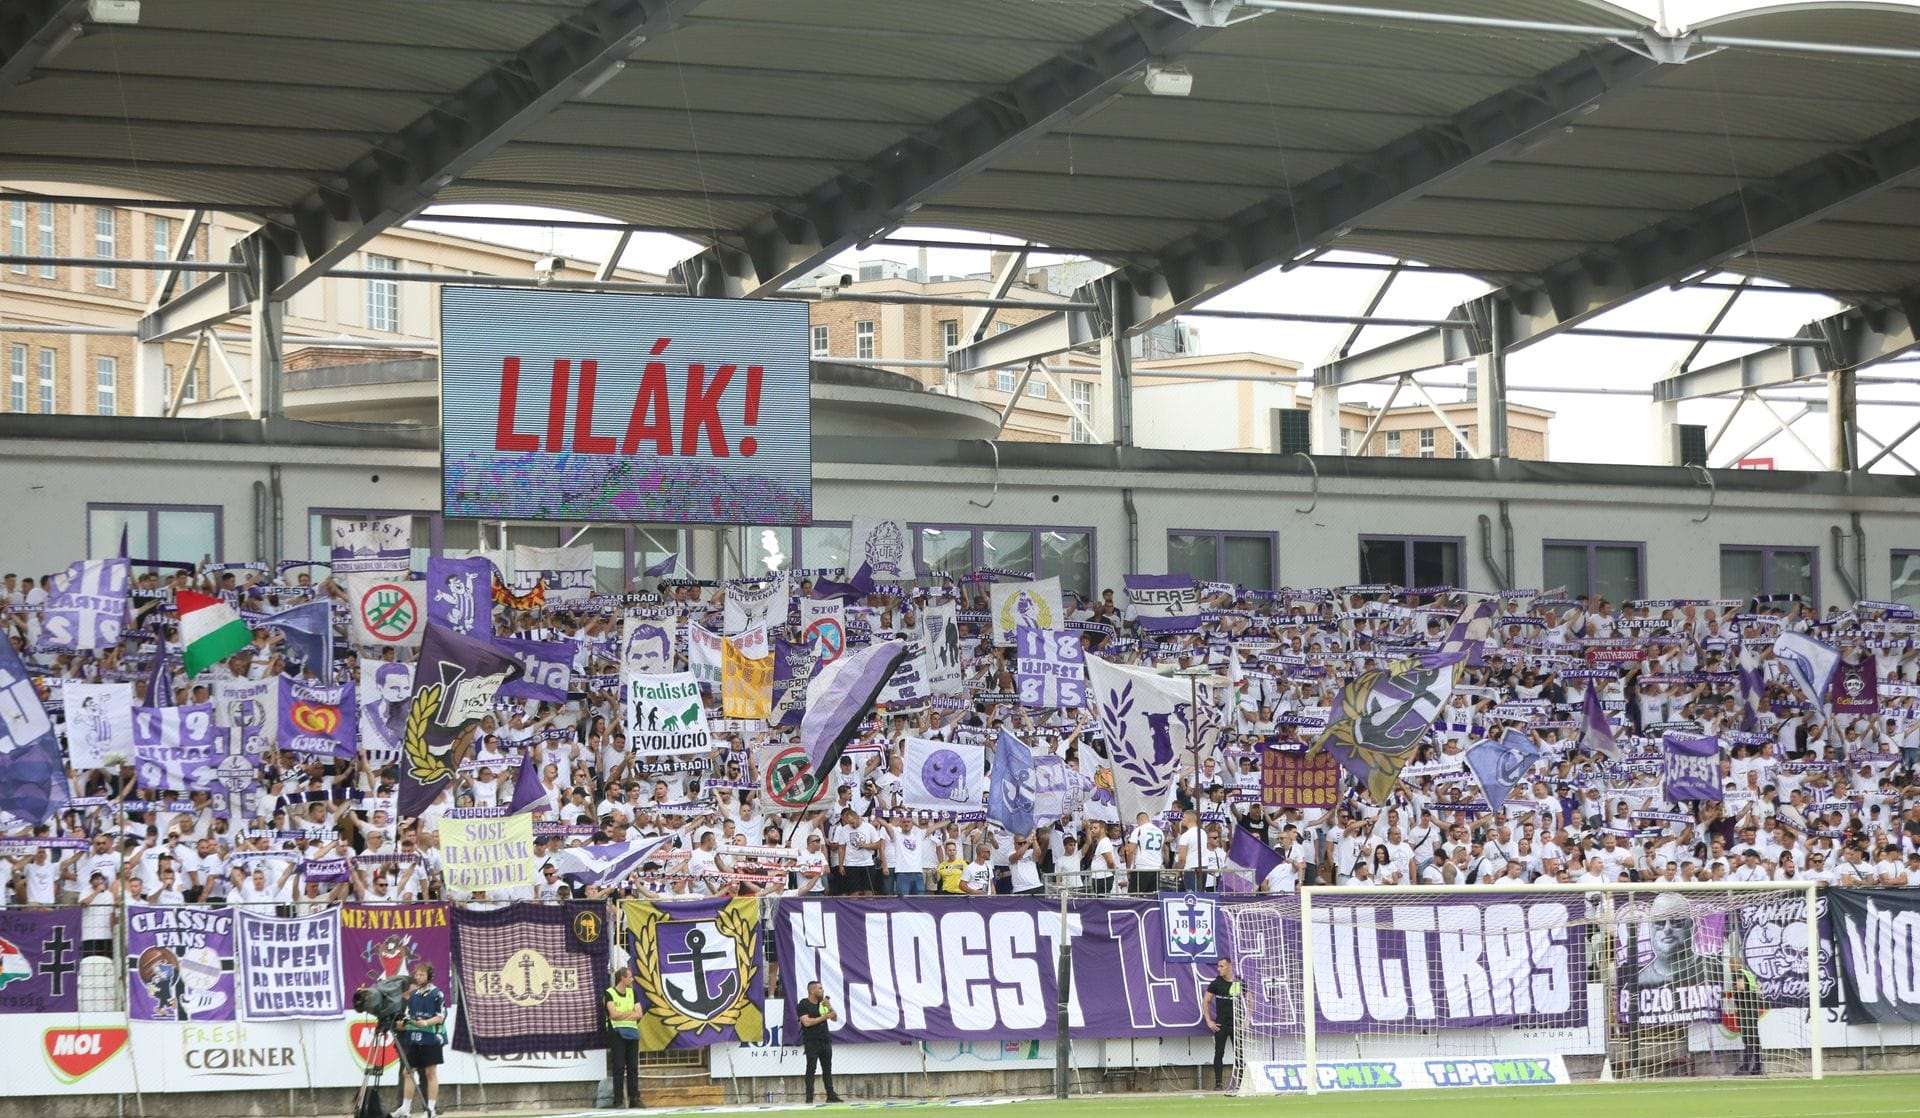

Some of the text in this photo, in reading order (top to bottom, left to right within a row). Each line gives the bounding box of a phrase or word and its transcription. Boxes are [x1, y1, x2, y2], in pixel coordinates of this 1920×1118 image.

[495, 338, 763, 457] LILÁK!
[627, 593, 658, 602] FRADI
[1130, 590, 1194, 602] ULTRAS
[811, 605, 839, 615] STOP
[1617, 619, 1641, 628] SZAR
[514, 651, 571, 690] tra
[1022, 659, 1079, 678] ÚJPEST
[632, 681, 698, 699] fradista
[632, 730, 707, 751] EVOLÚCIÓ
[642, 762, 671, 773] SZAR
[1264, 770, 1296, 787] UTE
[1264, 788, 1296, 805] UTE
[465, 821, 506, 841] SOSE
[1145, 832, 1163, 851] 23
[446, 841, 529, 864] HAGYUNK
[131, 908, 233, 935] CLASSIC
[248, 919, 330, 941] CSAK AZ
[1175, 919, 1188, 930] 18
[156, 931, 206, 948] FANS
[790, 901, 1085, 1031] ÚJPEST
[1311, 903, 1571, 1021] ULTRAS
[253, 972, 268, 987] AD
[52, 1034, 103, 1056] MOL
[182, 1027, 247, 1045] FRESH
[411, 1032, 422, 1042] 18
[185, 1047, 296, 1069] CORNER
